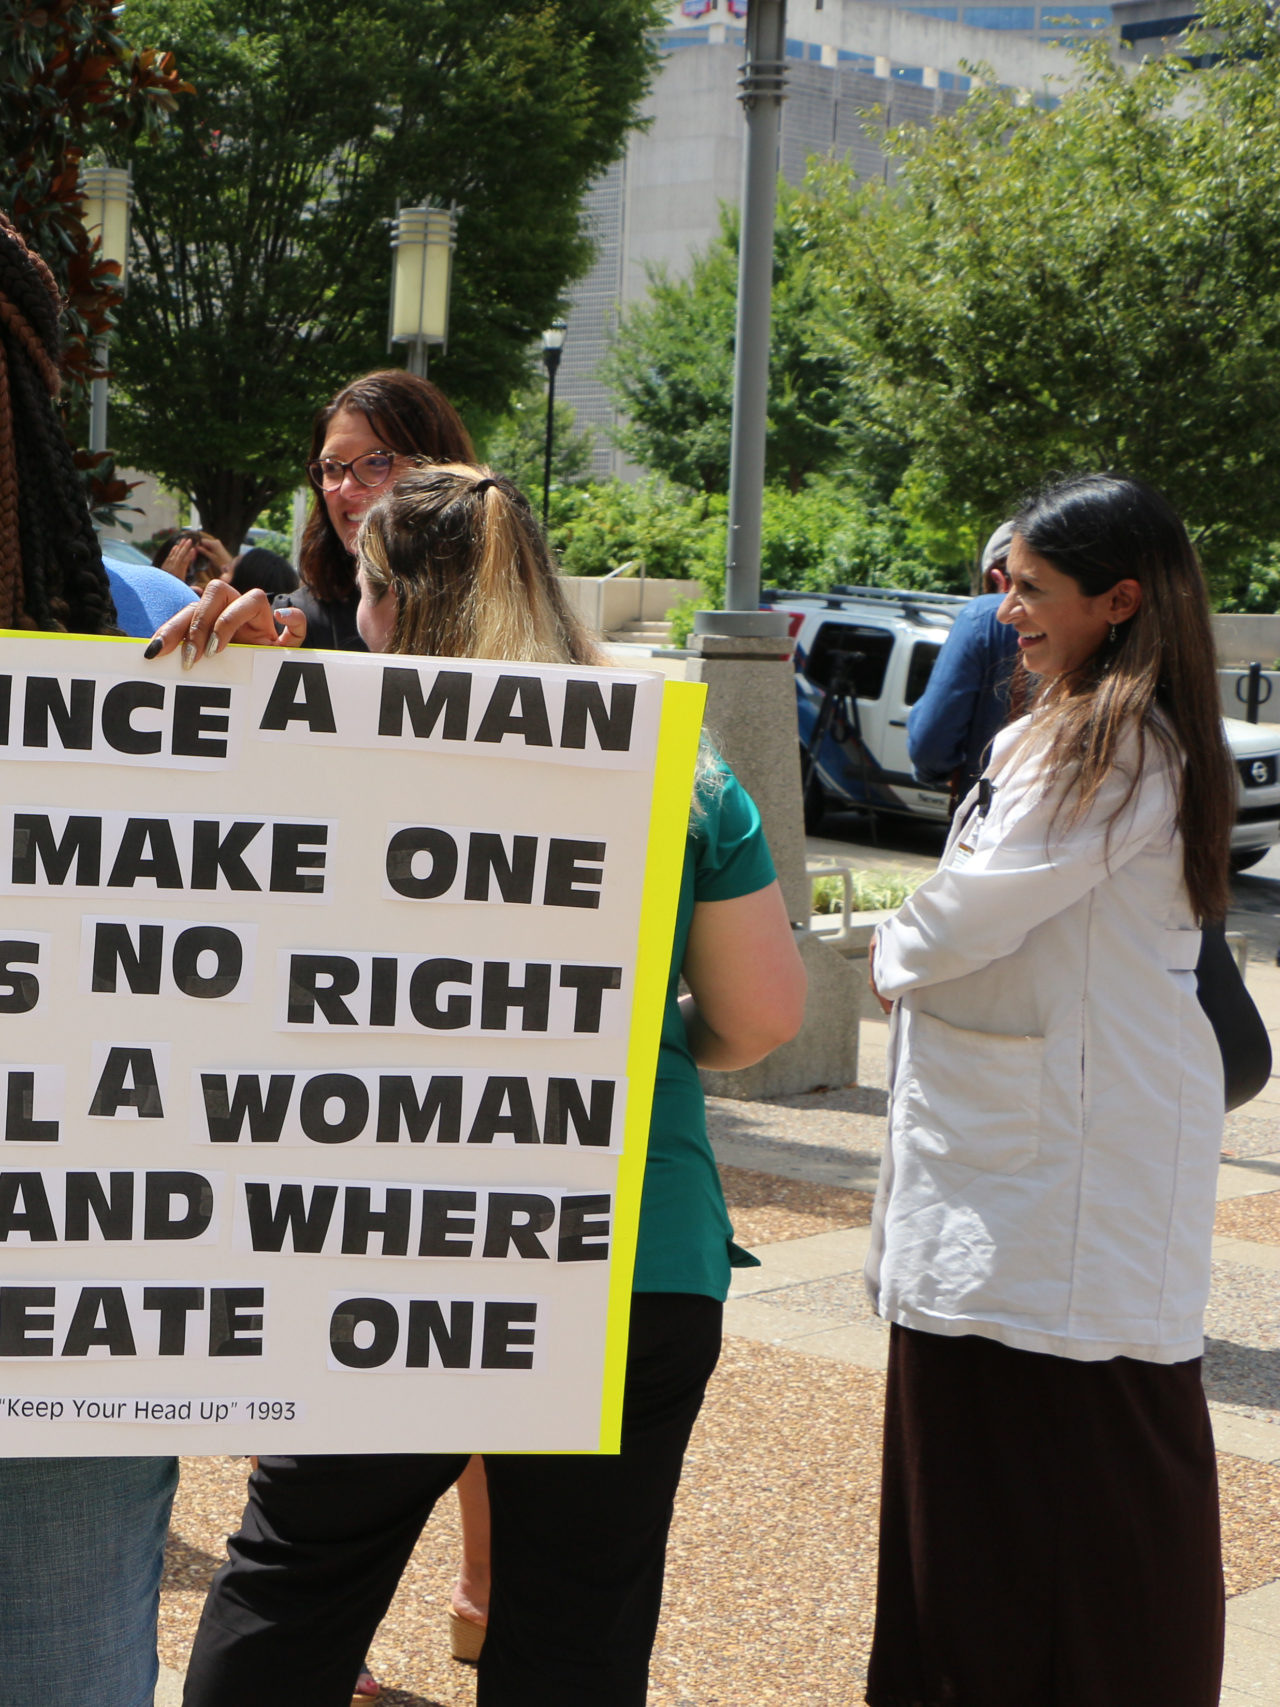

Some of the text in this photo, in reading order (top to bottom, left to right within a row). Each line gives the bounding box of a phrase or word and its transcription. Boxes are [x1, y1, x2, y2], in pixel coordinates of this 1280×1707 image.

[260, 662, 336, 732] A
[379, 668, 636, 751] MAN
[12, 814, 327, 893] MAKE
[387, 828, 605, 908] ONE
[92, 923, 242, 998] NO
[288, 955, 622, 1032] RIGHT
[89, 1048, 163, 1118] A
[201, 1074, 615, 1146] WOMAN
[245, 1183, 610, 1262] WHERE
[330, 1298, 536, 1369] ONE
[0, 1399, 63, 1420] "Keep
[73, 1400, 126, 1418] Your
[135, 1401, 191, 1419] Head
[201, 1402, 237, 1422] Up"
[246, 1402, 295, 1420] 1993
